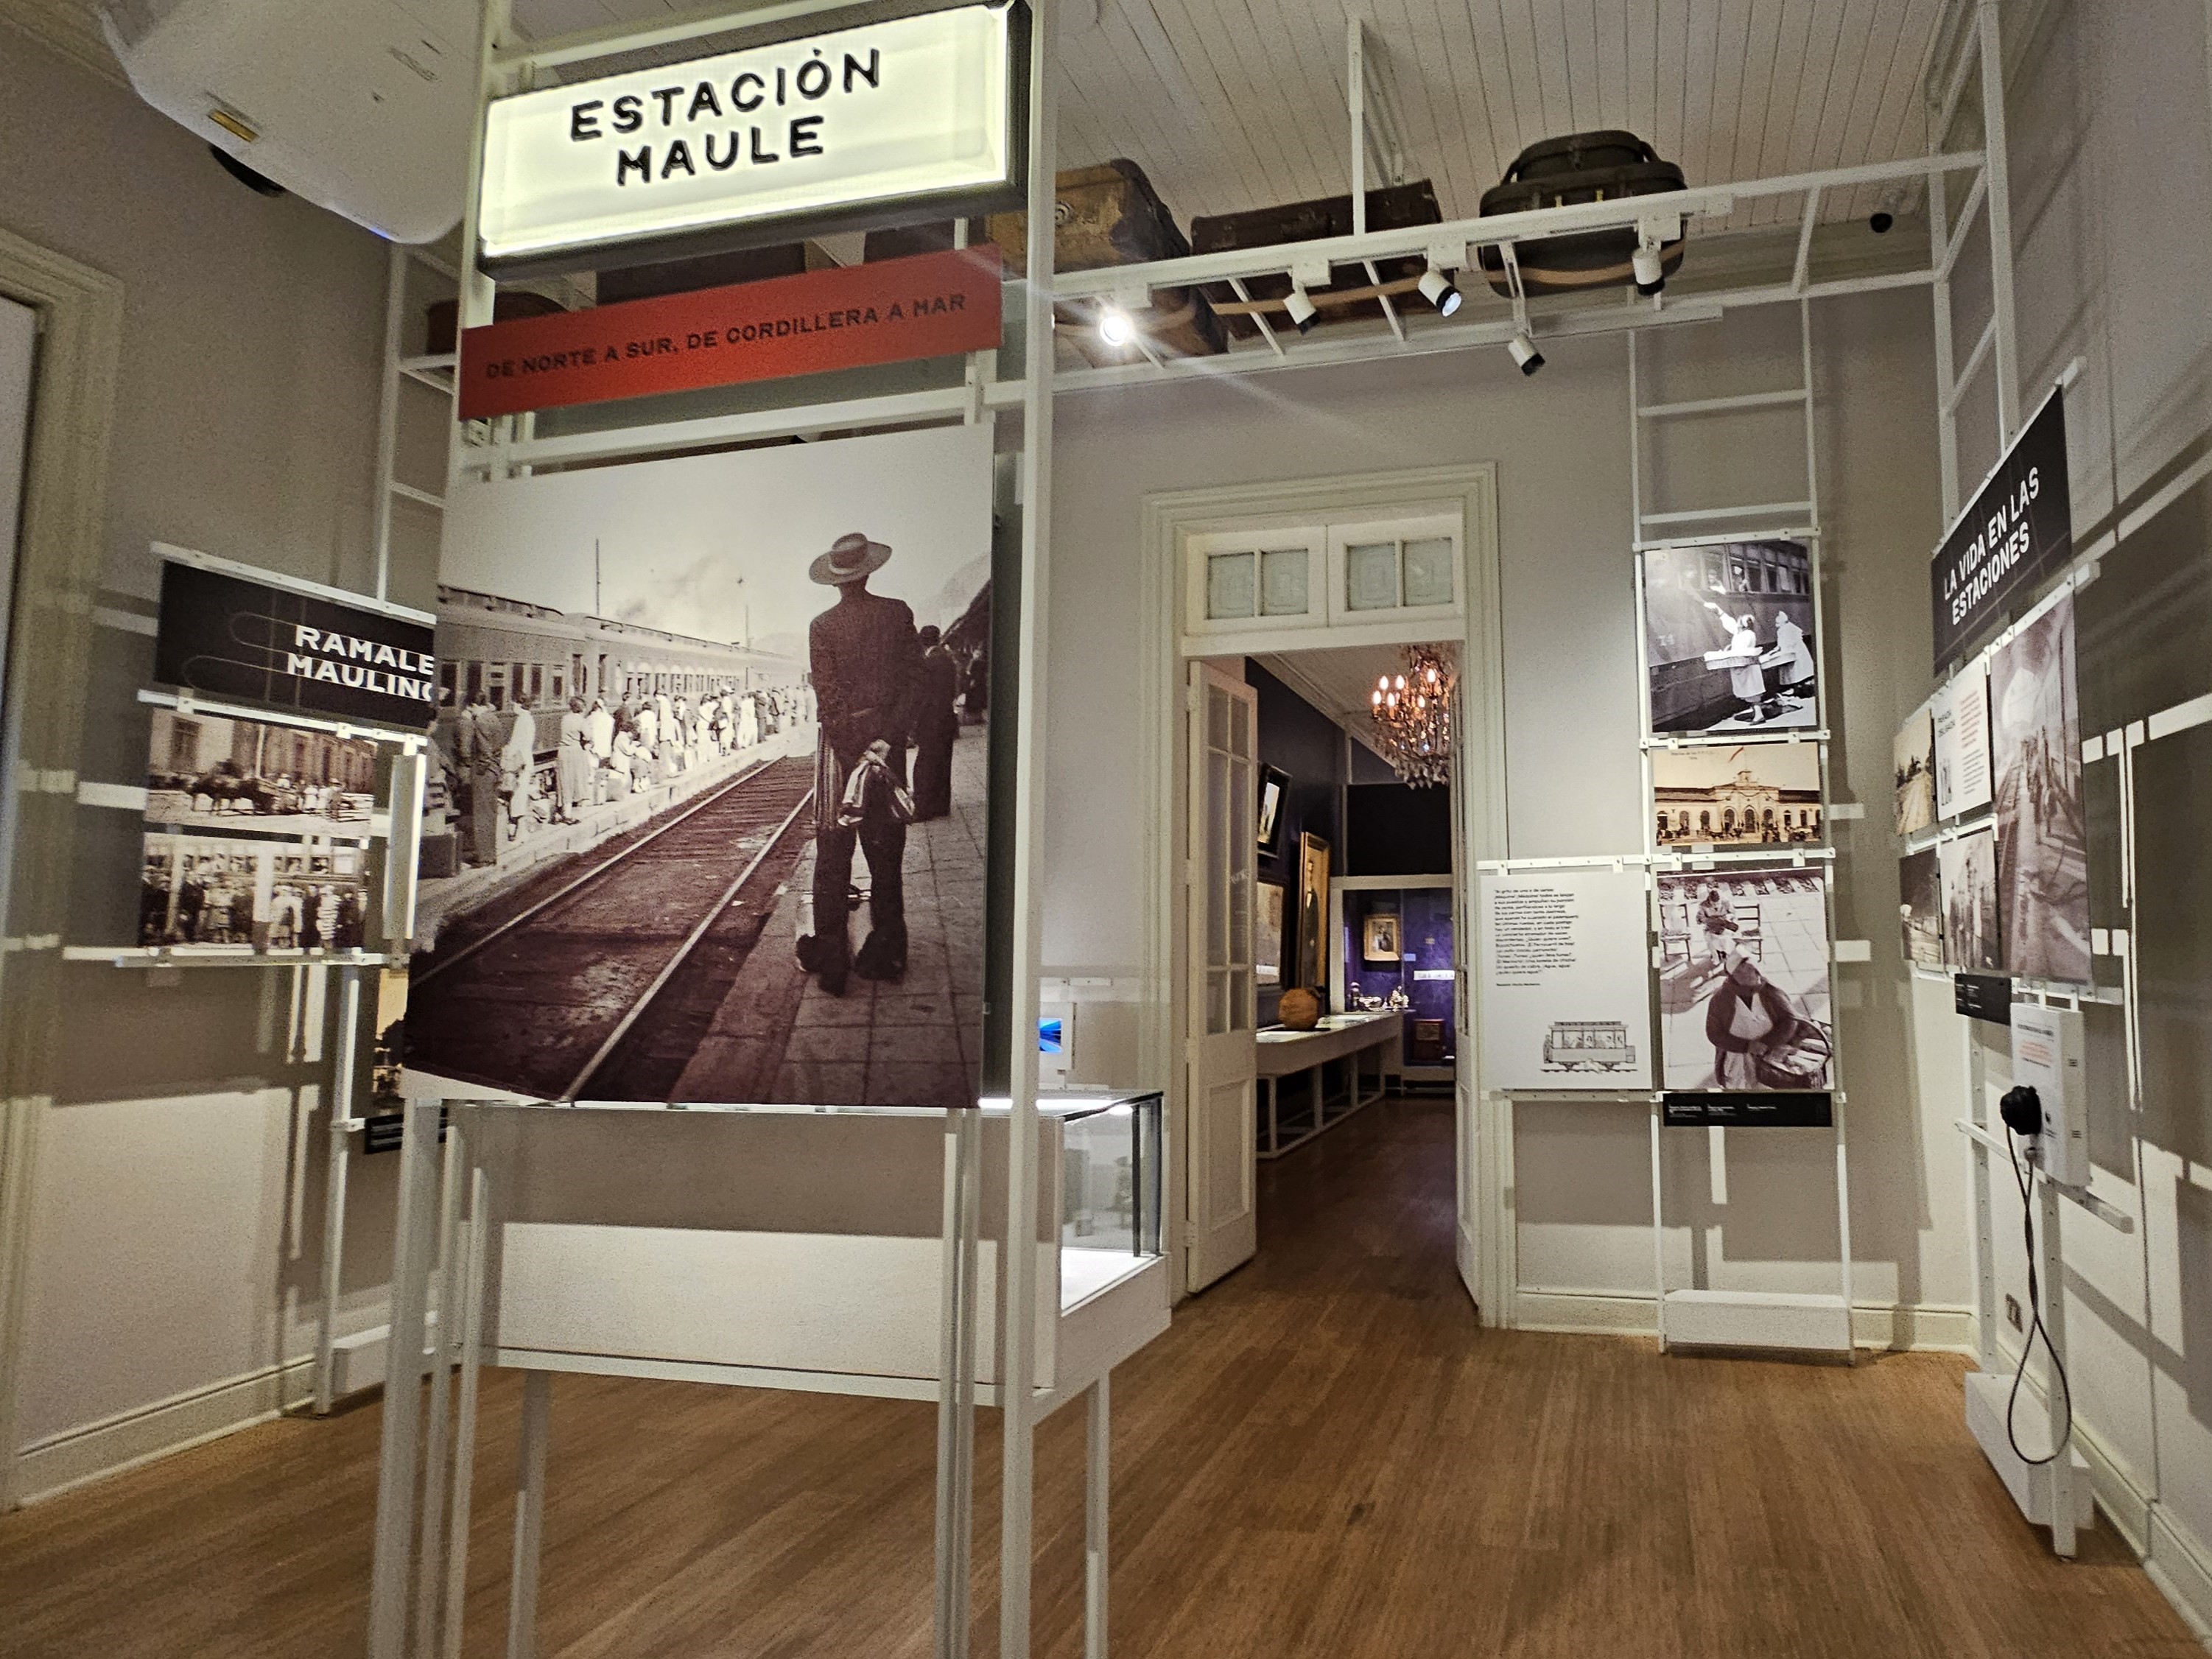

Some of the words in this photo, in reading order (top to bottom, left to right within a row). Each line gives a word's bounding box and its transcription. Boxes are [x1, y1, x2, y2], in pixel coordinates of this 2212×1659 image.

[571, 48, 879, 141] ESTACIÓN
[617, 115, 824, 186] MAULE
[485, 359, 516, 379] DE
[522, 347, 597, 373] NORTE
[604, 345, 620, 362] A
[687, 331, 718, 350] DE
[726, 307, 879, 344] CORDILLERA
[888, 302, 904, 321] A
[913, 295, 966, 318] MAR
[1944, 568, 1958, 600] LA
[1959, 533, 1986, 581] VIDA
[1988, 504, 2007, 549] EN
[2010, 466, 2040, 522] LAS
[1951, 521, 2029, 625] ESTACIONES
